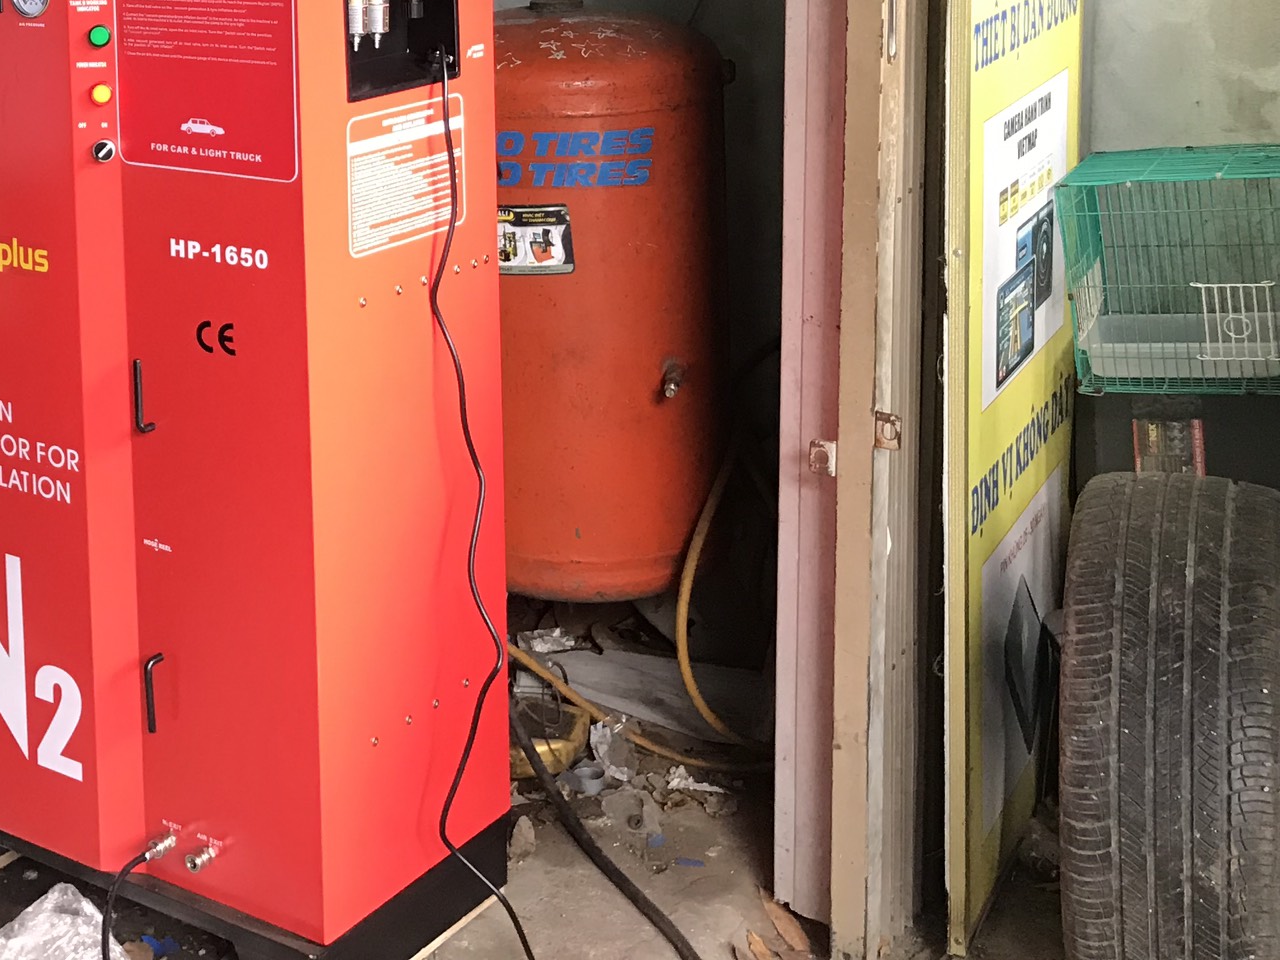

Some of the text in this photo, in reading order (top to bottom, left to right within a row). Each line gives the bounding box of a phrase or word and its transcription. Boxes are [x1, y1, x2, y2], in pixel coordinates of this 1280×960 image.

[1003, 109, 1023, 141] CAMERA
[150, 142, 262, 162] FOR CAR & LIGHT TRUCK
[532, 127, 655, 157] TIRES
[1017, 128, 1037, 160] VIETMAP
[528, 159, 652, 187] TIRES
[170, 238, 269, 269] HP-1650
[196, 320, 236, 356] CE
[36, 442, 79, 472] FOR
[971, 459, 999, 538] ĐỊNH
[1001, 442, 1014, 500] VỊ
[1015, 401, 1049, 481] KHÔNG
[143, 538, 158, 548] HOSE
